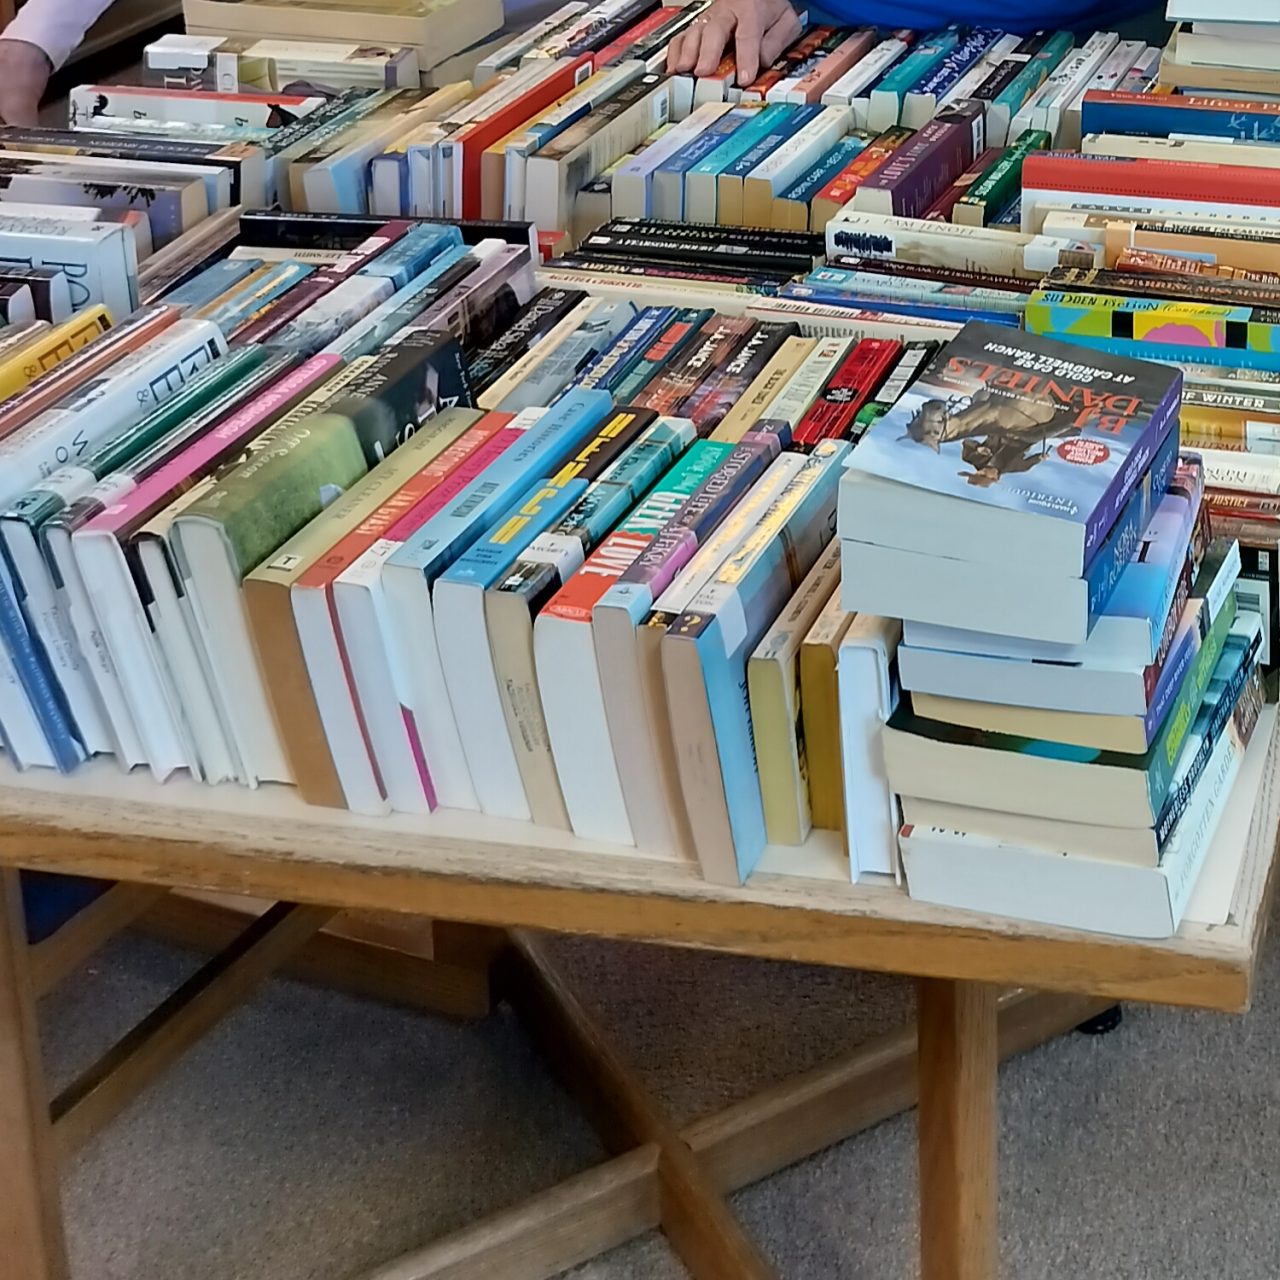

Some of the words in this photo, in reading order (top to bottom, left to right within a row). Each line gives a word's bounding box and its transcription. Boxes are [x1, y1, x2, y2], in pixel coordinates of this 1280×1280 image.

[1188, 97, 1229, 109] Life
[1233, 100, 1252, 109] of
[983, 341, 1034, 361] RANCH
[1013, 355, 1052, 373] CASE
[1035, 353, 1113, 380] CARDWELL
[1051, 365, 1092, 383] COLD
[947, 356, 1142, 416] DANIELS
[1112, 372, 1135, 385] AT
[1203, 393, 1265, 408] WINTER
[236, 443, 287, 483] Season
[488, 409, 636, 547] HENCH
[1213, 495, 1249, 508] JUSTICE
[624, 491, 690, 533] GEEK
[579, 535, 650, 581] LOVE
